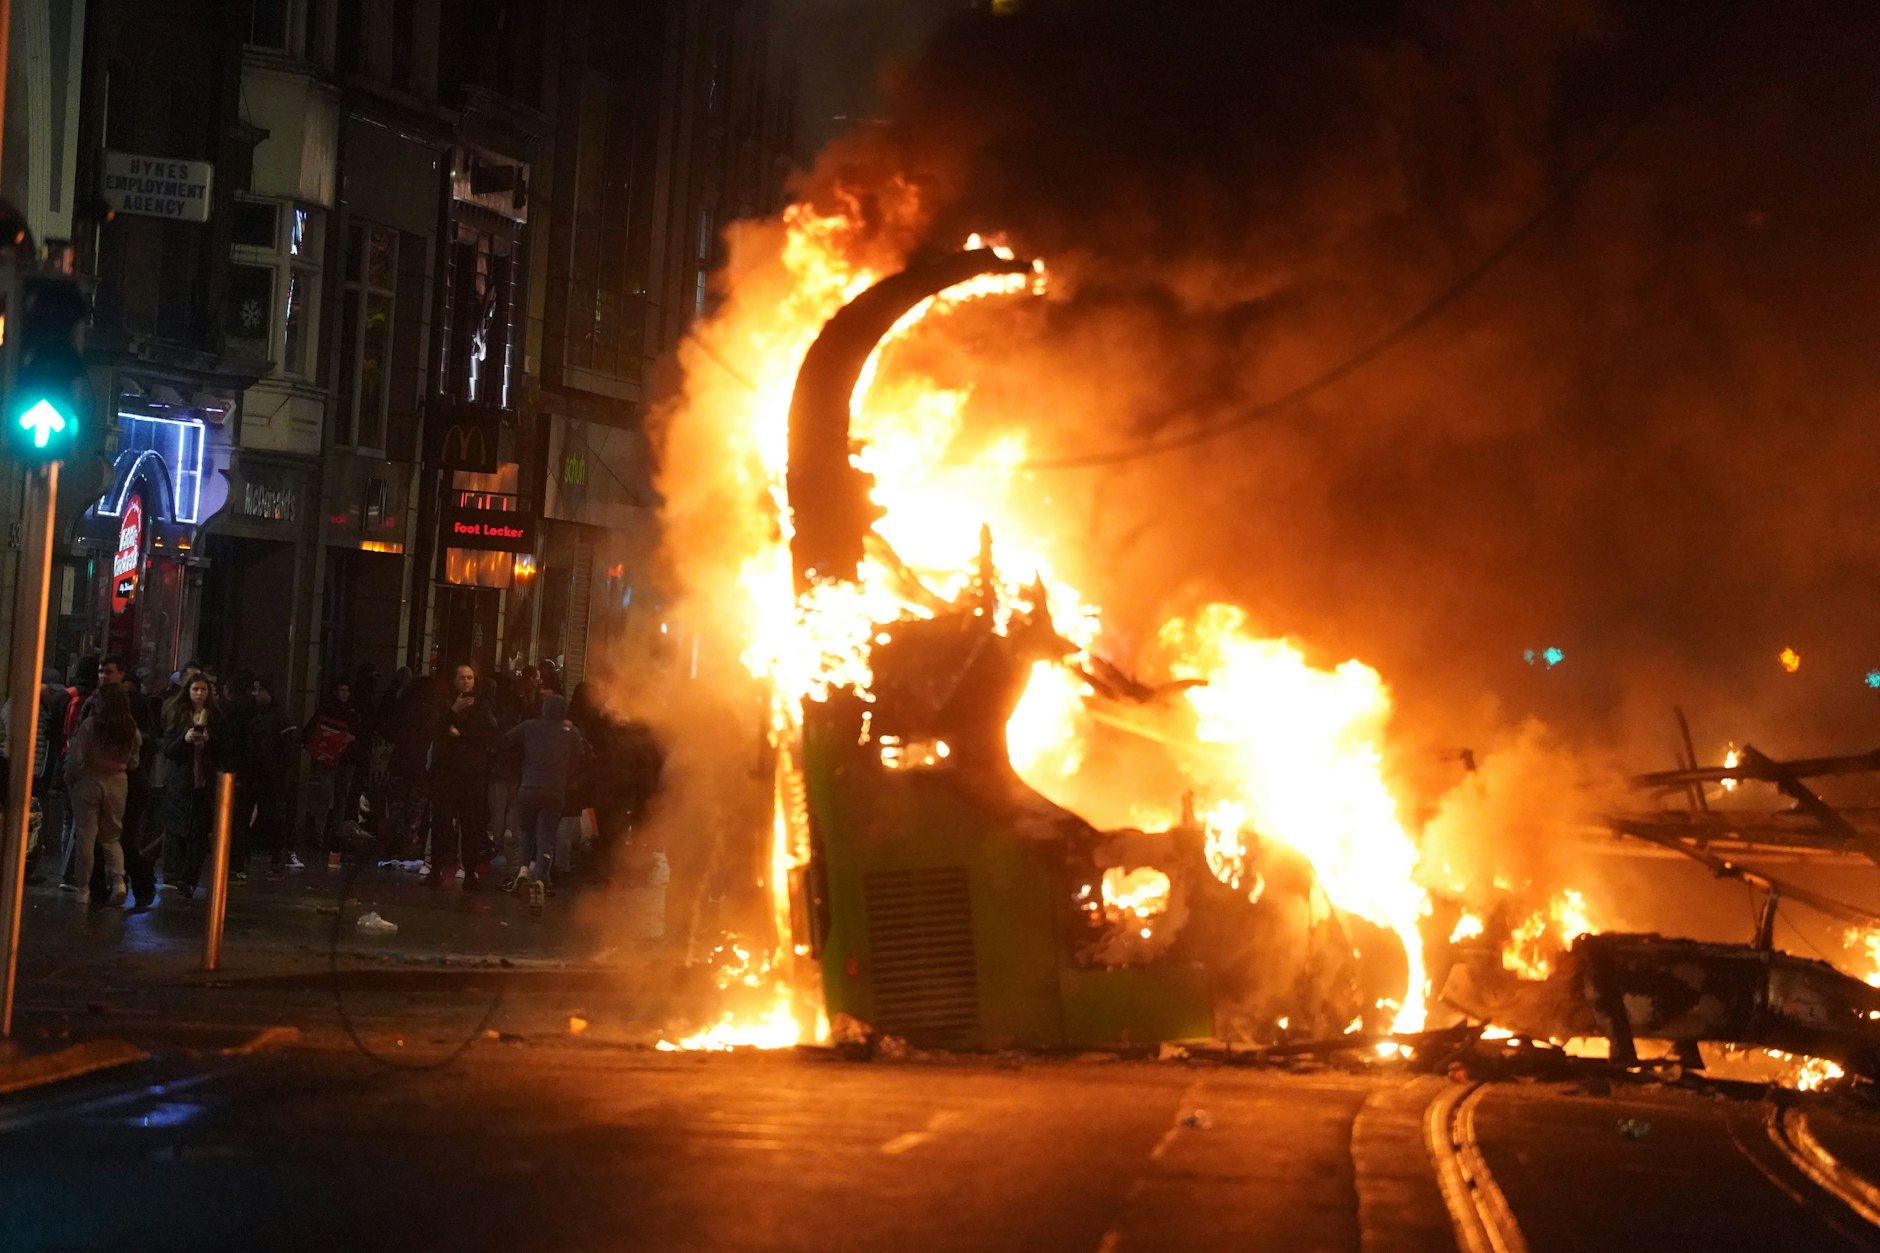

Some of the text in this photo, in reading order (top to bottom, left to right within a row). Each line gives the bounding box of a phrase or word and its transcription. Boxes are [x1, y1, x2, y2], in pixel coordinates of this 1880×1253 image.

[130, 159, 189, 180] HYNES
[106, 175, 206, 199] EMPLOYMENT
[123, 195, 186, 216] AGENCY
[454, 522, 523, 538] Foot Locker
